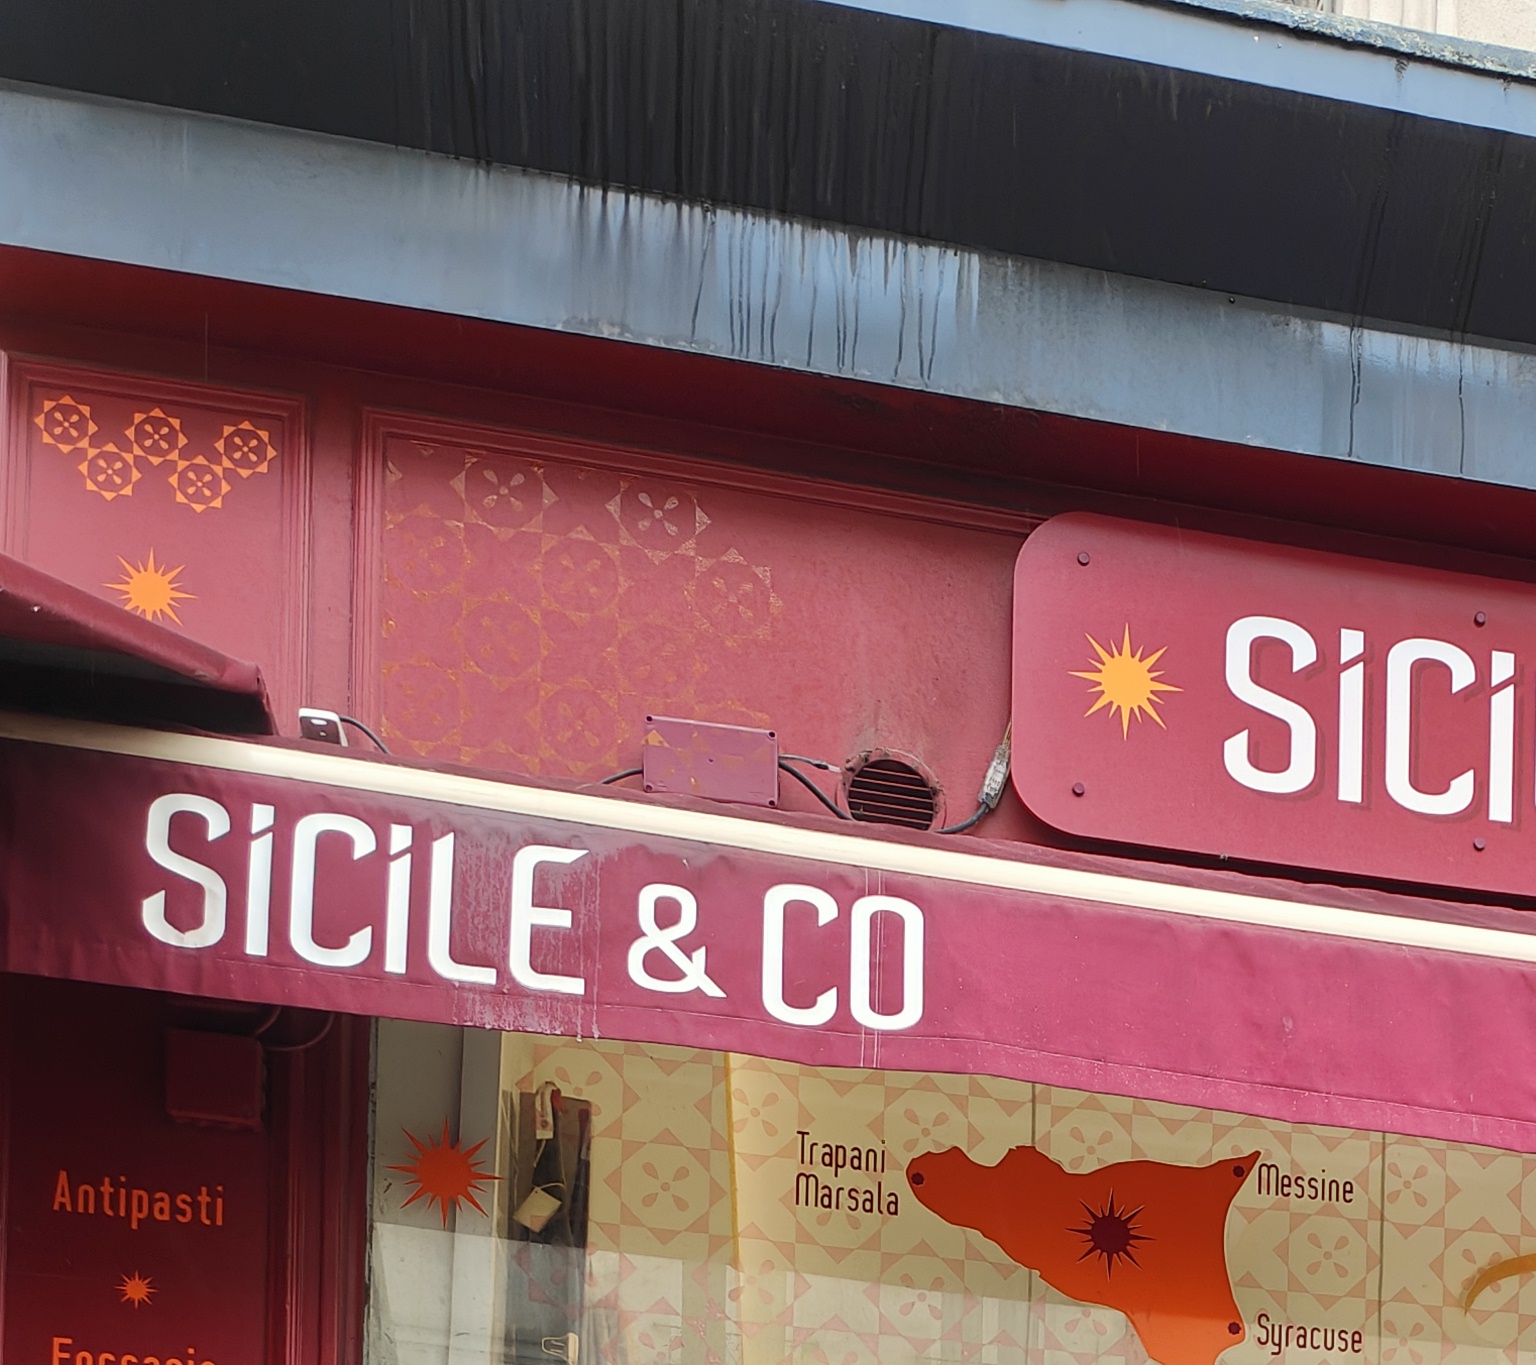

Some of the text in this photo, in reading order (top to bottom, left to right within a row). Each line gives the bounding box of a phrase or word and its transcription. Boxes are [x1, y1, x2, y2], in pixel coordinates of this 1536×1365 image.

[626, 883, 728, 999] &
[761, 883, 925, 1032] CO
[796, 1130, 886, 1176] Trapani
[52, 1169, 225, 1231] Antipasti
[795, 1171, 900, 1217] Marsala
[1256, 1163, 1355, 1205] Messine
[1256, 1312, 1364, 1356] Syracuse
